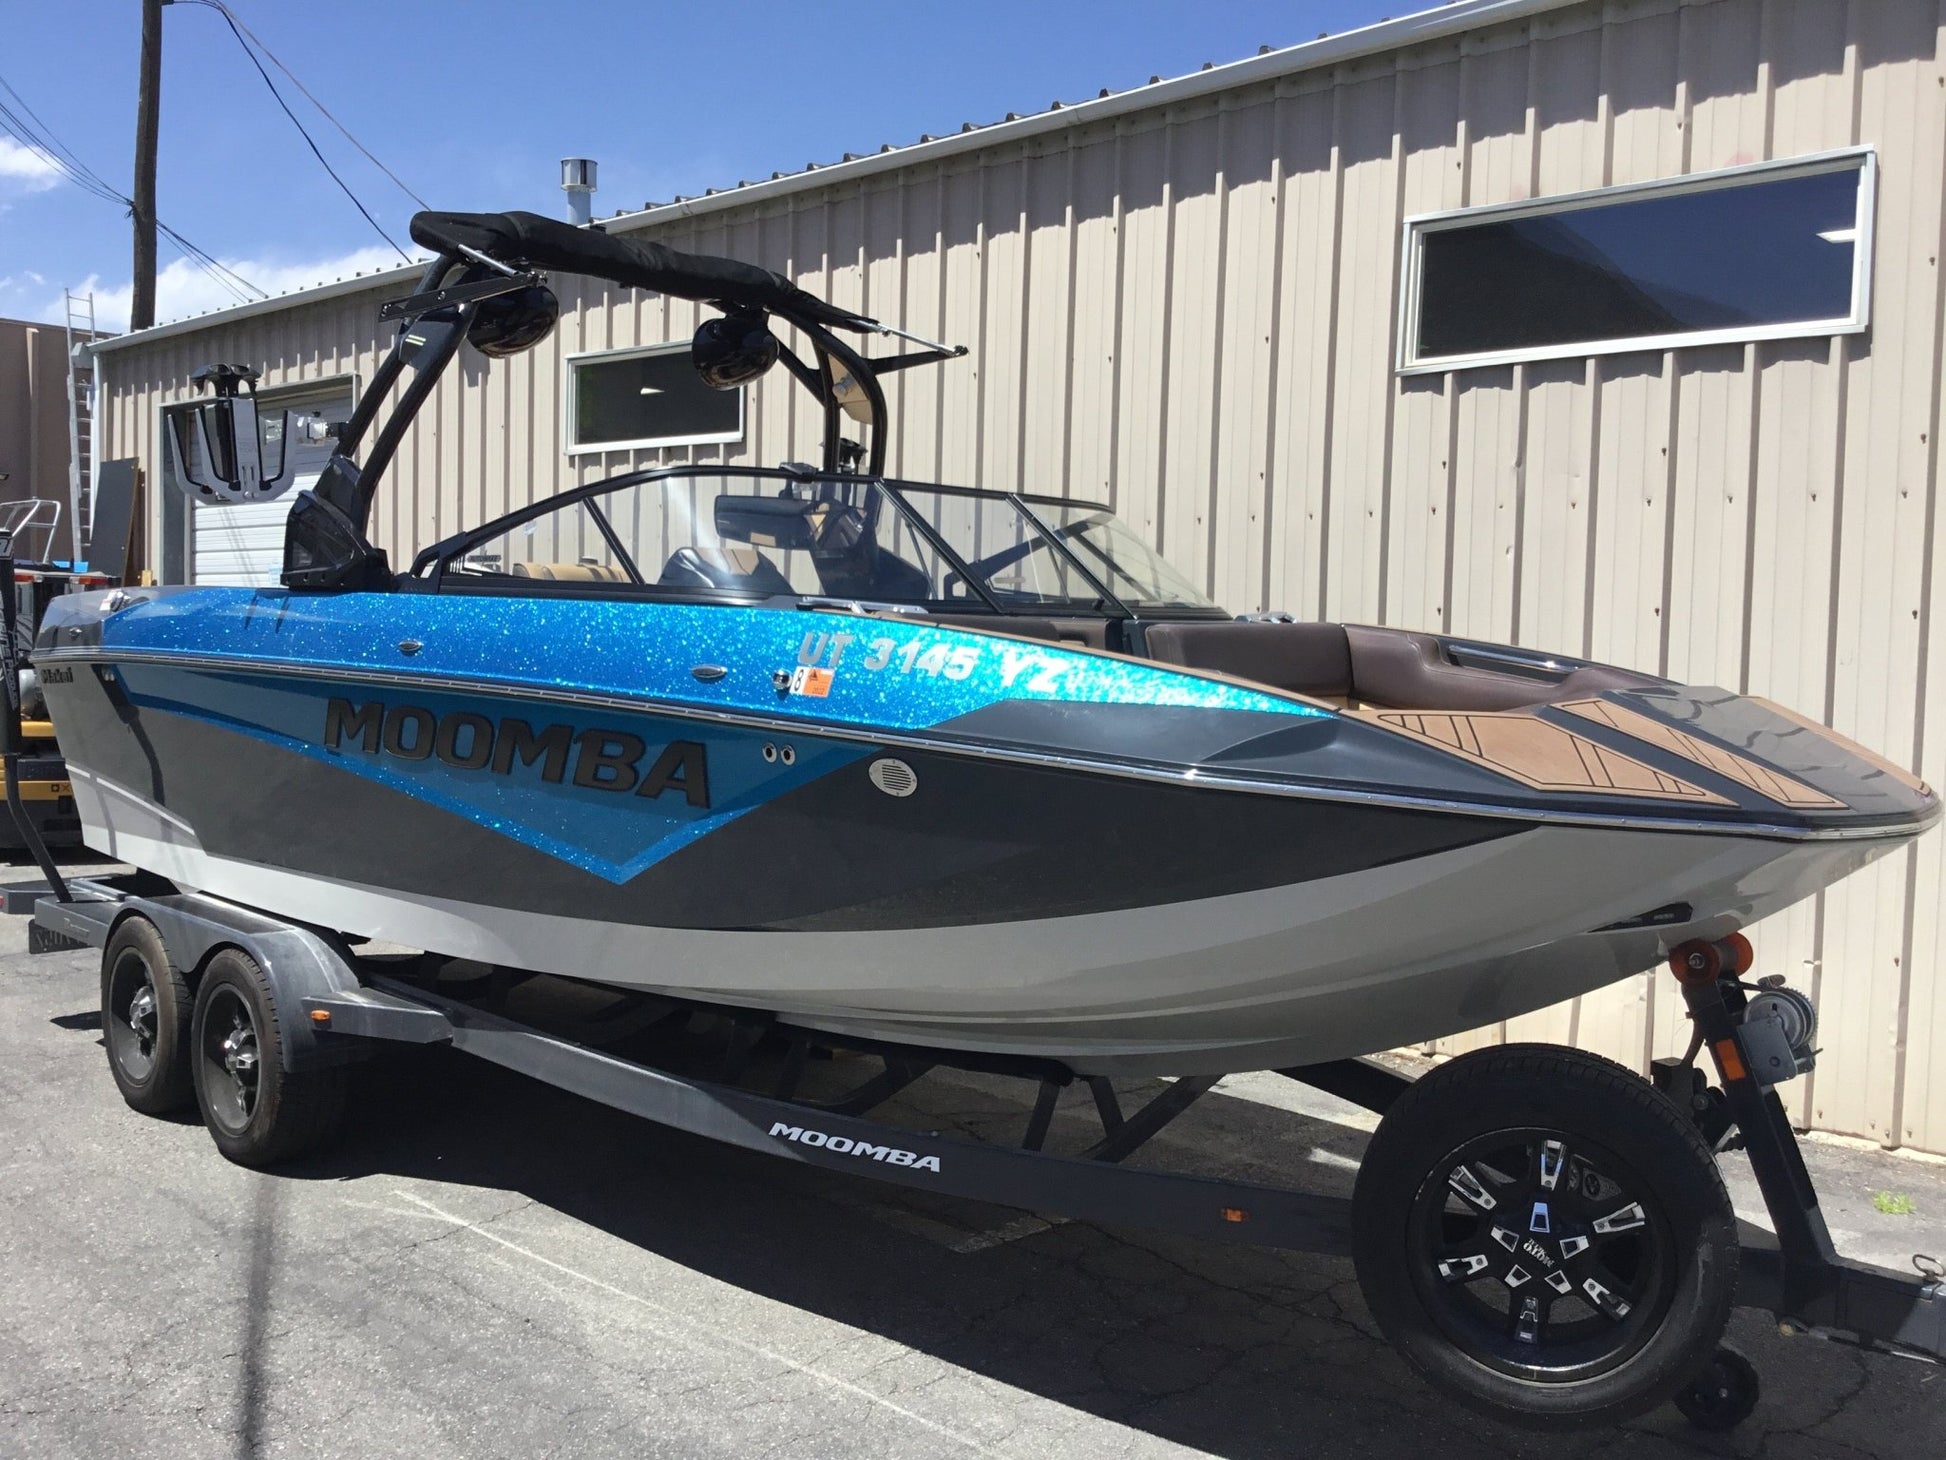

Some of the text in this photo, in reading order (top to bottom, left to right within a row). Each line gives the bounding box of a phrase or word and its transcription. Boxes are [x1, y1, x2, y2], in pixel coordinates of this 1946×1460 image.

[797, 632, 1070, 693] UT 3145 YZ
[325, 697, 711, 809] MOOMBA
[769, 1122, 940, 1173] MOOMBA
[1523, 1242, 1555, 1268] MOTO
